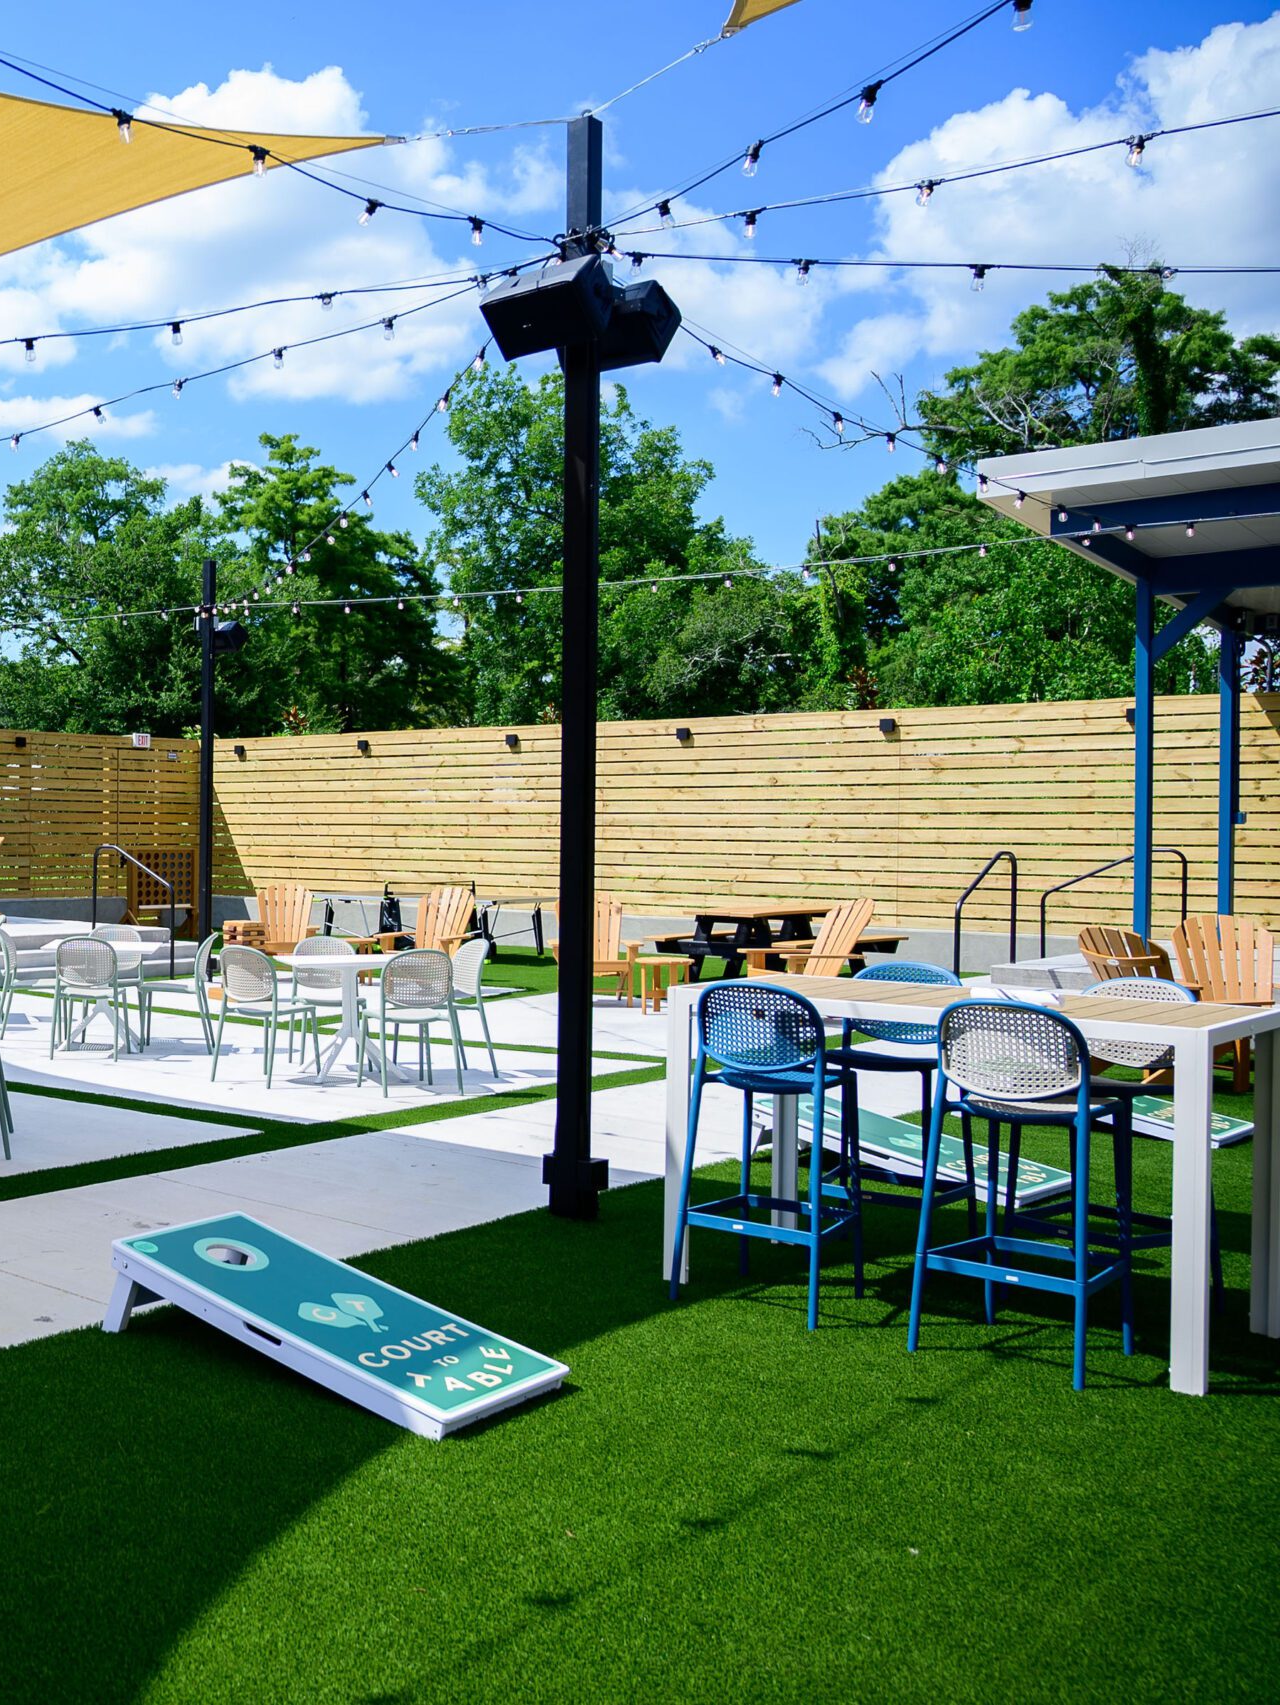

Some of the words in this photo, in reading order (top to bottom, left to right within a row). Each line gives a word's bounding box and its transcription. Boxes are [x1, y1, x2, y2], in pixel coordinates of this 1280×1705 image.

[137, 735, 149, 746] EXIT
[358, 1322, 470, 1368] COURT
[406, 1345, 514, 1392] TABLE
[433, 1355, 460, 1367] TO
